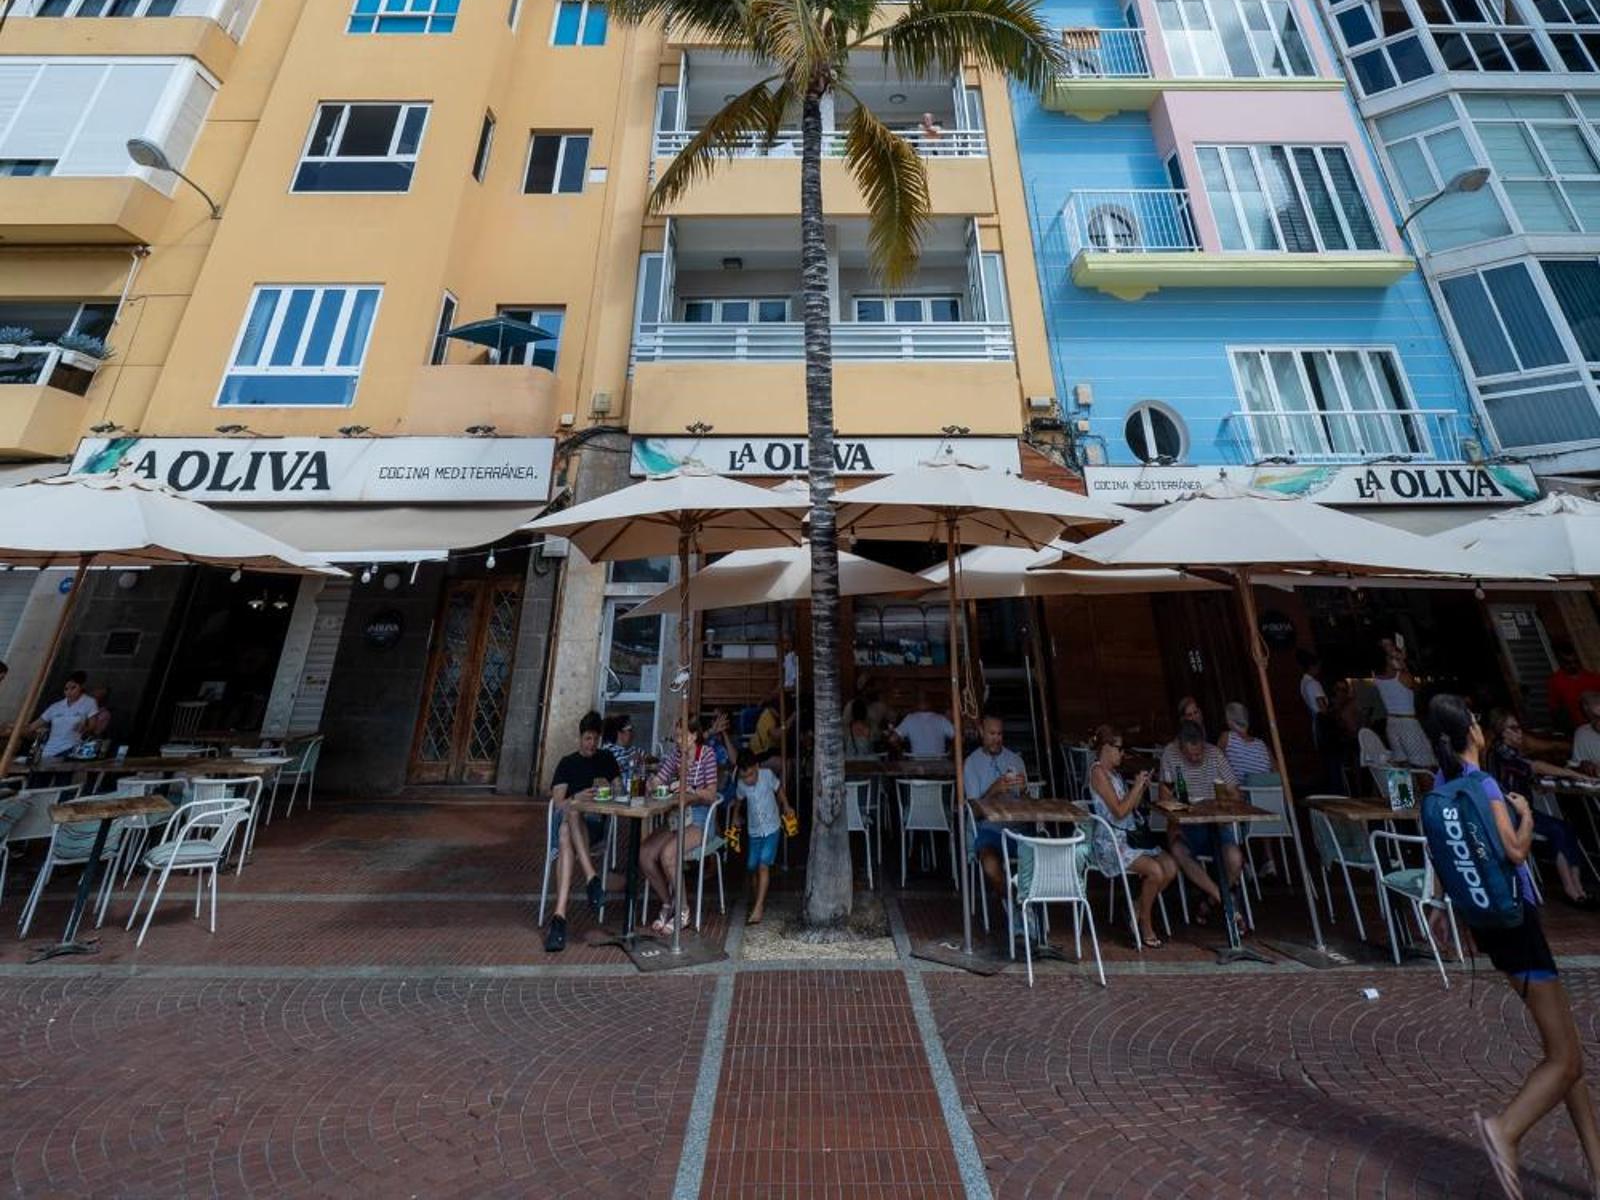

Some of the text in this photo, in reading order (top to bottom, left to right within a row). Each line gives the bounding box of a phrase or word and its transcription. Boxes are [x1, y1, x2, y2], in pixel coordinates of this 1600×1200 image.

[134, 450, 331, 492] A OLIVA
[729, 443, 875, 471] LA OLVA
[378, 466, 430, 480] COCINA
[1093, 480, 1129, 491] COCINA
[1354, 469, 1503, 499] LA OLIVA
[1442, 807, 1490, 909] adidas
